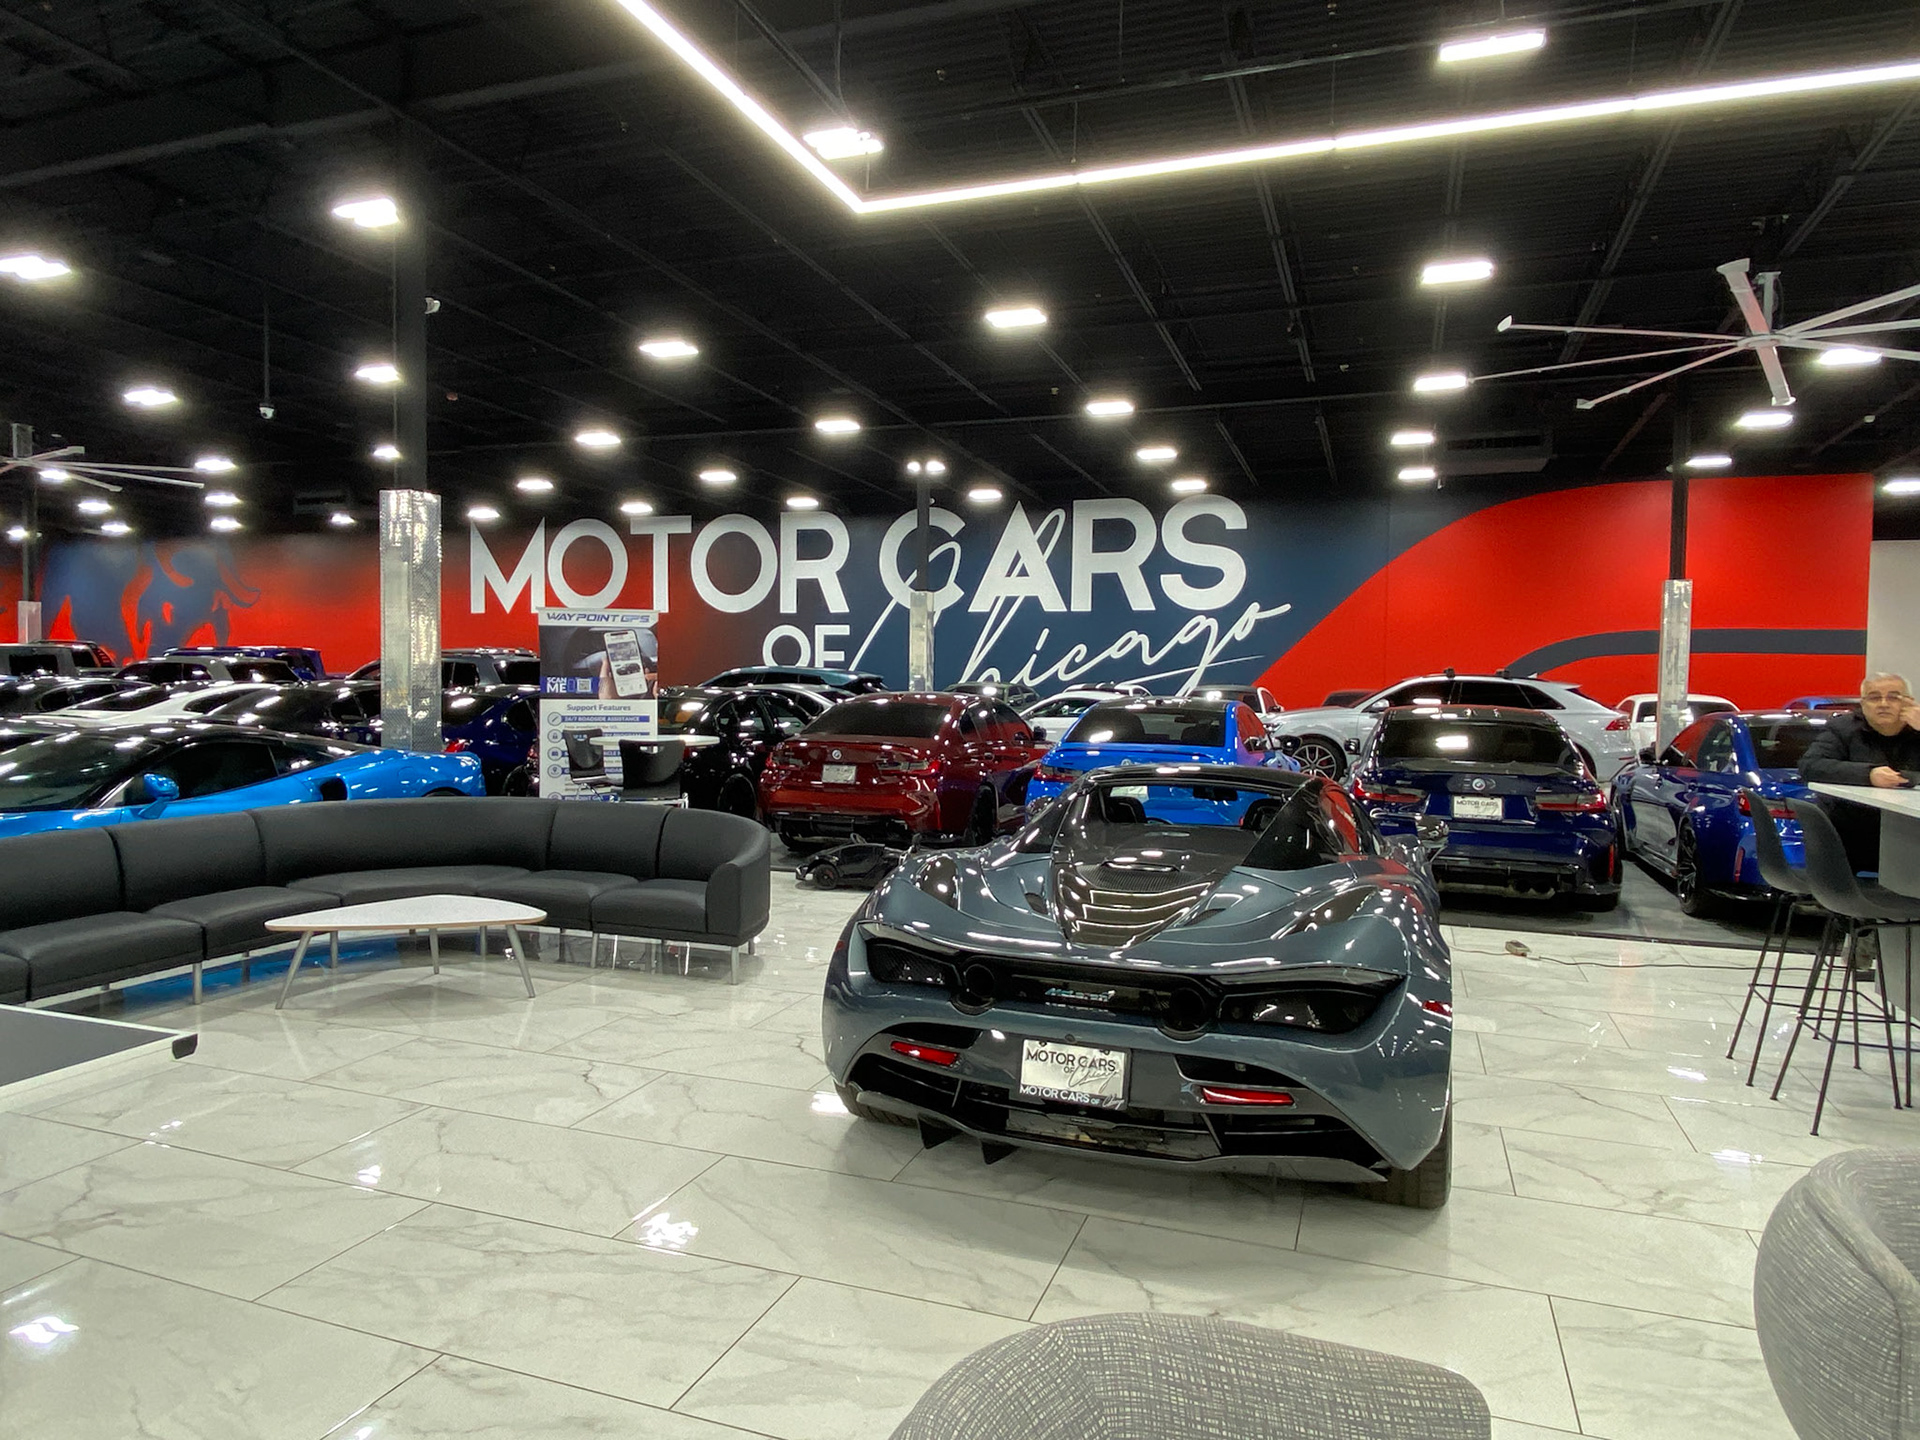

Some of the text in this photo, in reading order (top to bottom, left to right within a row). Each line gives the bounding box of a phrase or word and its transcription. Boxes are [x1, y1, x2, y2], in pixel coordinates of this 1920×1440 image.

[470, 493, 1248, 614] MOTOR CARS
[620, 614, 651, 624] GPS
[762, 623, 850, 668] OF
[546, 683, 567, 694] ME
[566, 703, 632, 712] Support Features
[1026, 1047, 1117, 1072] MOTOR CARS
[1063, 1065, 1076, 1074] OF
[1020, 1084, 1058, 1099] MOTOR
[1060, 1090, 1091, 1104] CARS
